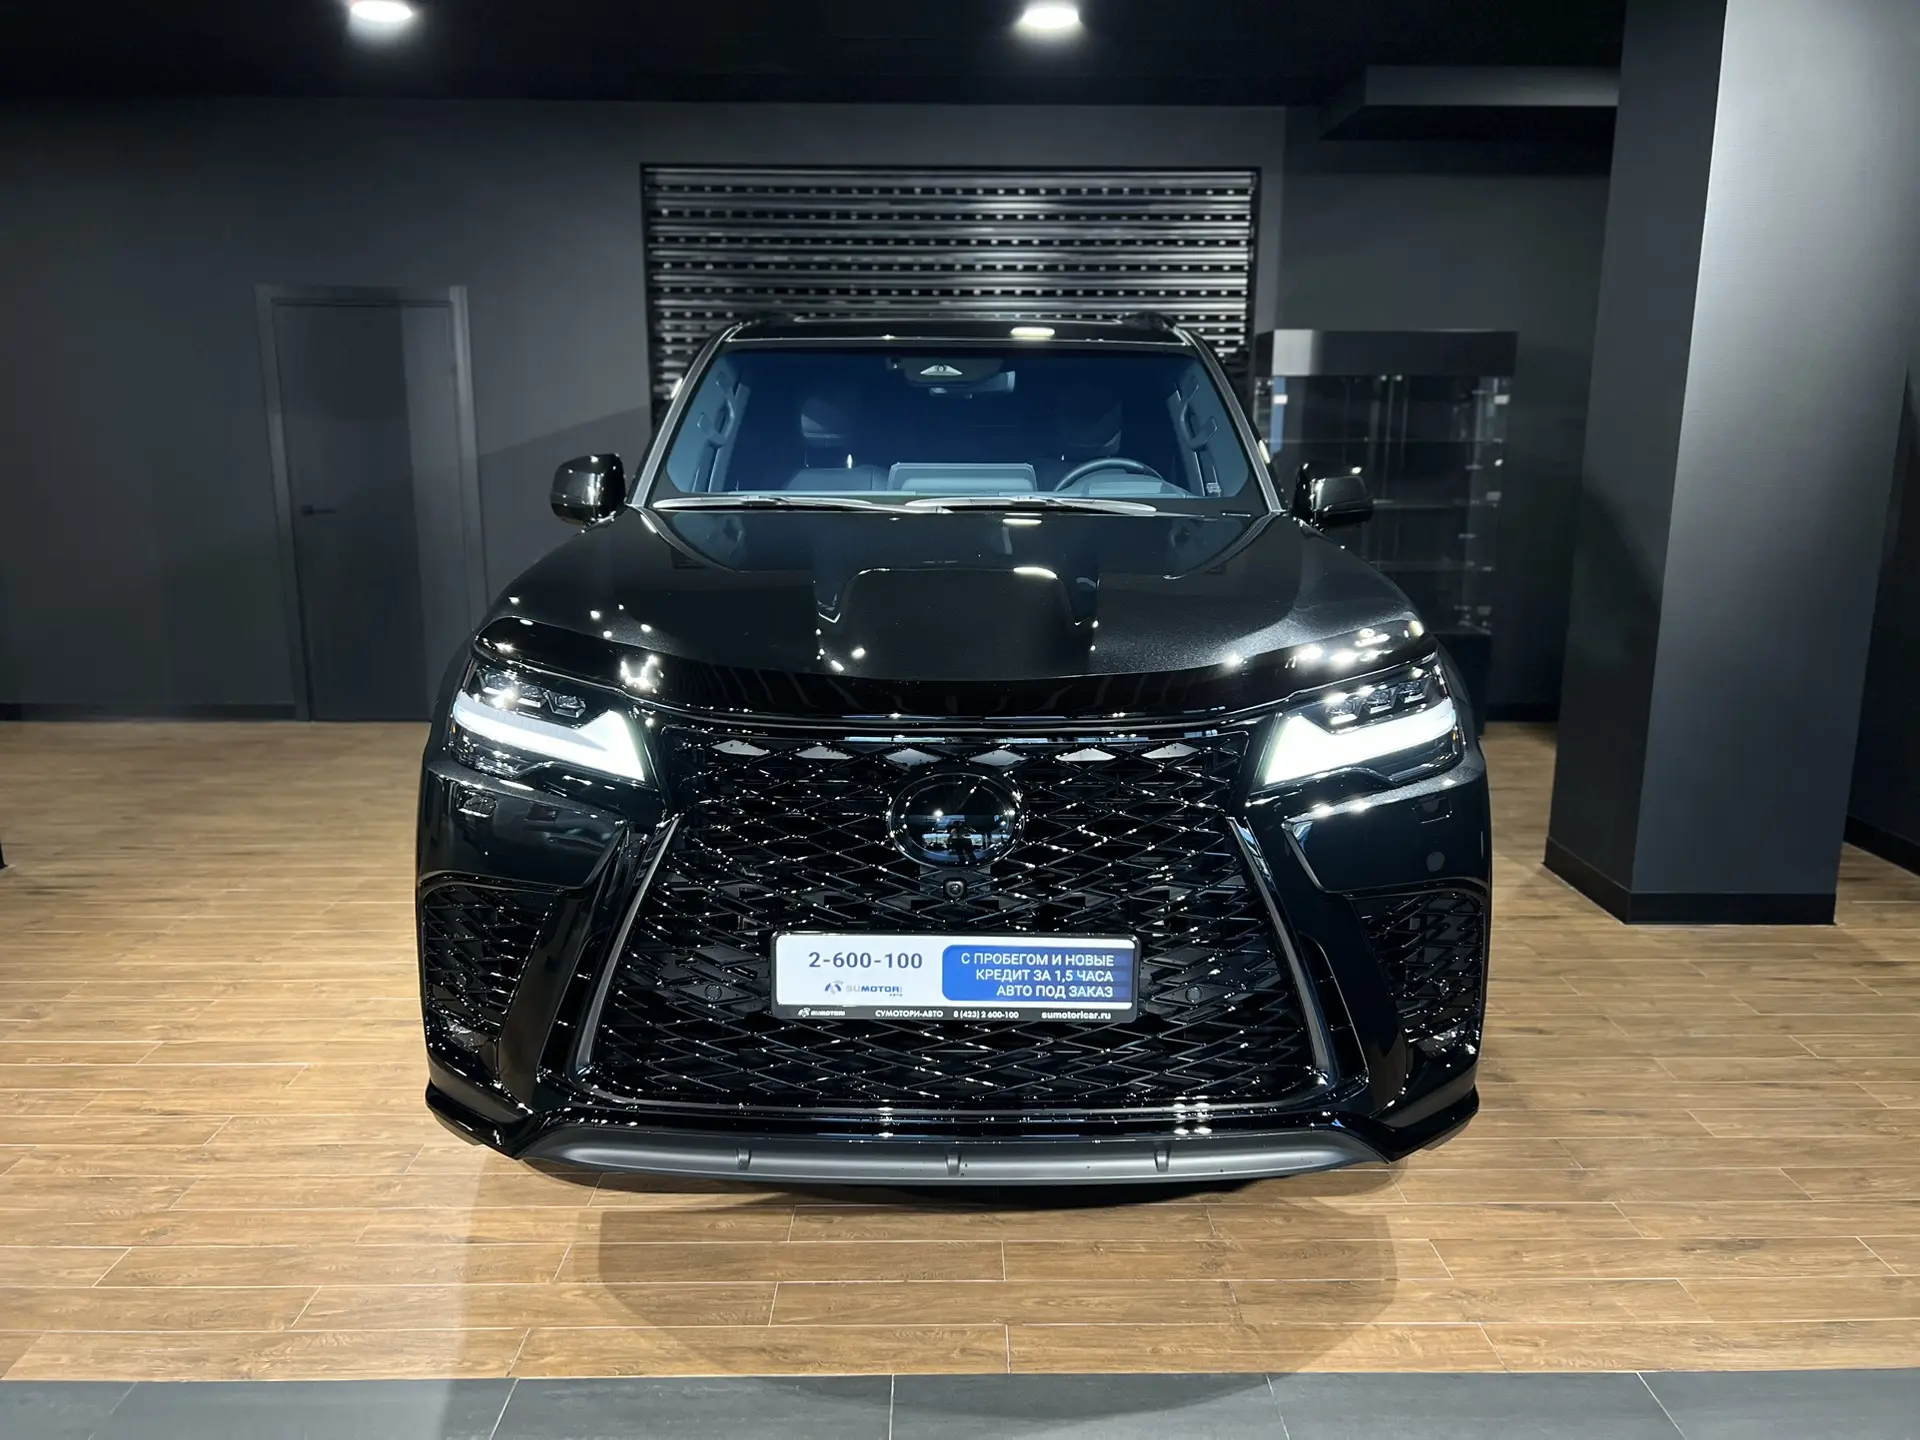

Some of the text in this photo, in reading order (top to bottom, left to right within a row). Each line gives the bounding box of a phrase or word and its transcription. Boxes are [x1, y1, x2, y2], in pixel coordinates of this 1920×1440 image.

[808, 951, 923, 969] 2-600-100
[961, 953, 1114, 966] С ПРОБЕГОМ И НОВЫЕ
[976, 969, 1114, 983] КРЕДИТ ЗА 1,5 ЧАСА
[996, 985, 1113, 999] АВТО ПОД ЗАКАЗ
[875, 1009, 944, 1018] СУМОТОРИ-АВТО
[960, 1010, 980, 1019] (423)
[987, 1010, 1020, 1019] 600-100
[1041, 1010, 1112, 1019] sumotoricar.ru
